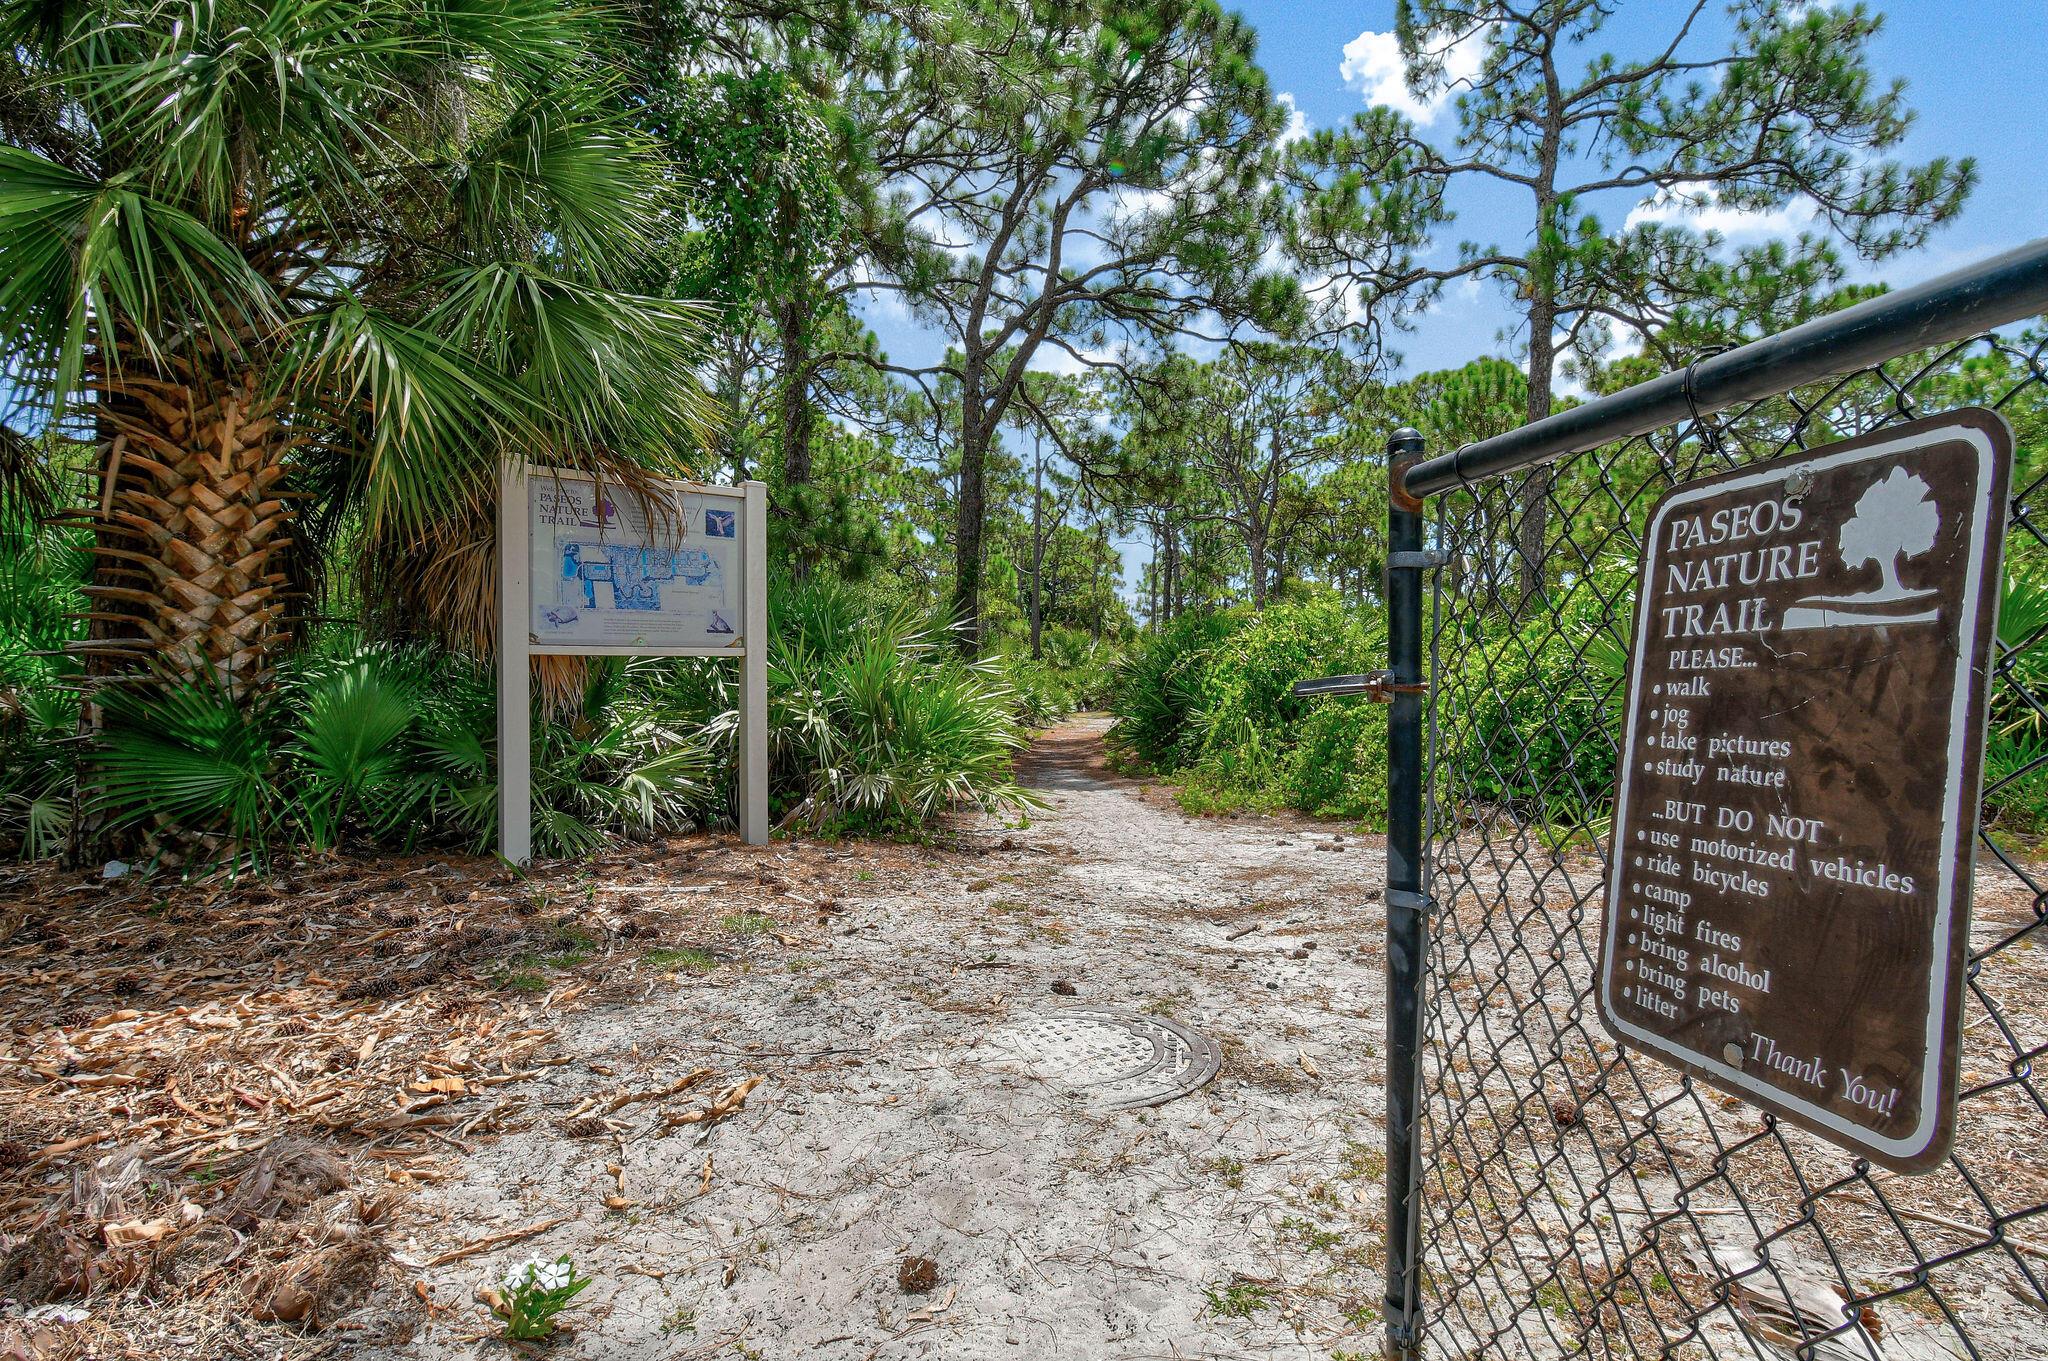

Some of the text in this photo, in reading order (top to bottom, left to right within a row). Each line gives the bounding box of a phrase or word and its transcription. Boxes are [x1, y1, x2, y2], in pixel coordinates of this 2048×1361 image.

[539, 504, 588, 517] NATURE
[540, 493, 582, 505] PASEOS
[539, 515, 577, 526] TRAIL
[1667, 497, 1802, 552] PASEOS
[1665, 540, 1821, 595] NATURE
[1662, 597, 1772, 638] TRAIL
[1668, 647, 1757, 670] PLEASE...
[1666, 676, 1711, 697] walk
[1661, 703, 1689, 729] jog
[1660, 730, 1791, 759] take pictures
[1656, 758, 1786, 788] study nature
[1652, 799, 1824, 844] ...BUT DO NOT
[1647, 853, 1769, 897] ride bicycles
[1650, 829, 1915, 894] use motorized vehicles
[1645, 883, 1692, 913] camp
[1642, 905, 1741, 951] light fires
[1641, 932, 1771, 993] bring alcohol
[1636, 985, 1678, 1019] litter
[1638, 958, 1740, 1014] bring pets
[1750, 1032, 1898, 1118] Thank You!
